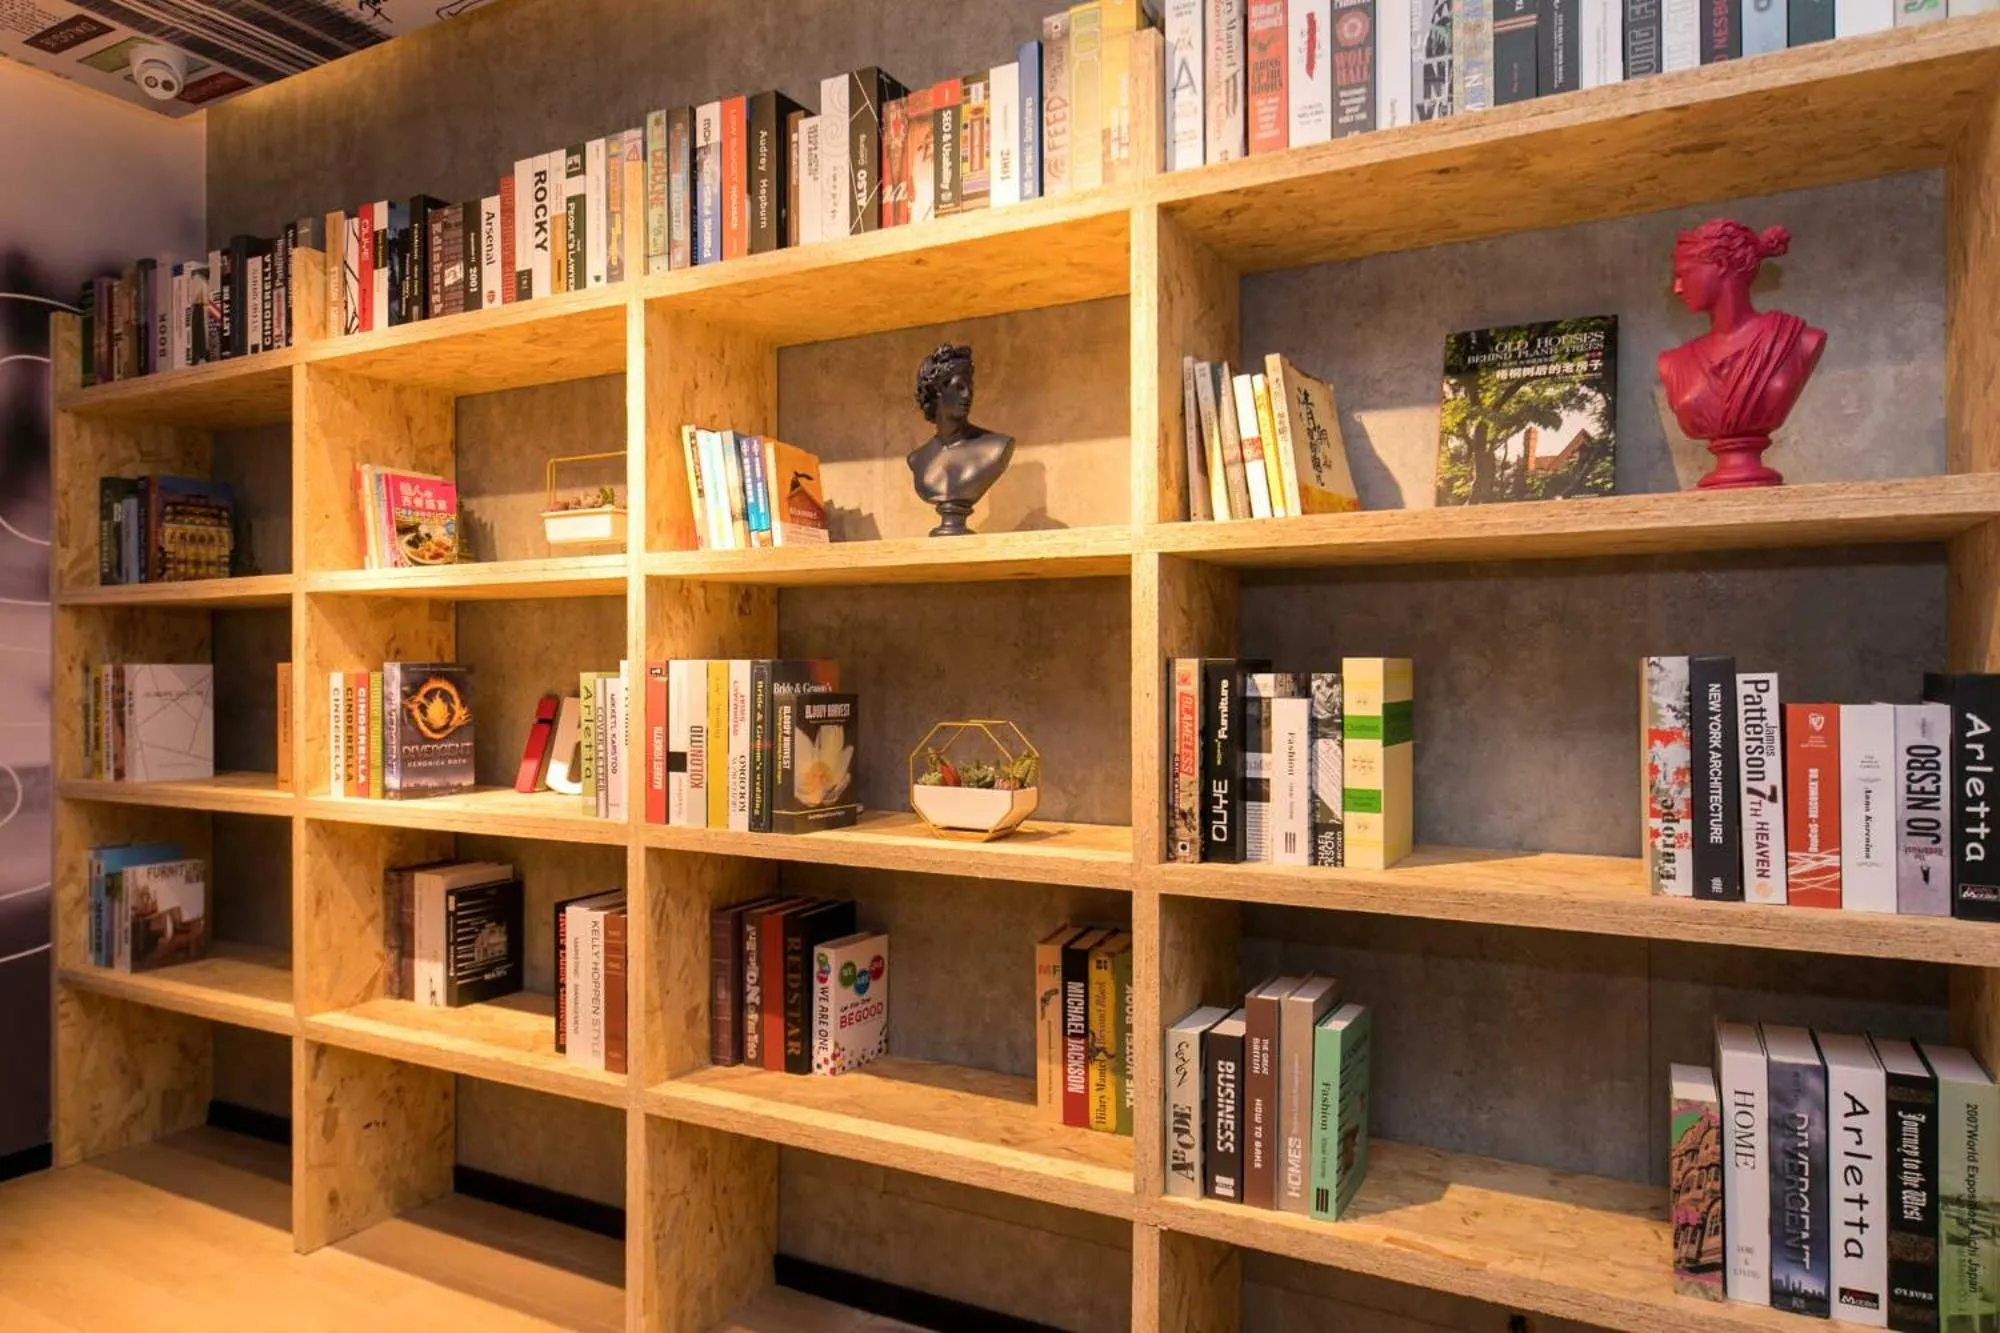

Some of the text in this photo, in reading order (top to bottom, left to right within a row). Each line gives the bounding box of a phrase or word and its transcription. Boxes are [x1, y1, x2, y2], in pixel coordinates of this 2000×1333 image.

[942, 109, 952, 130] SEO
[1047, 95, 1069, 152] FEED
[758, 130, 768, 229] Audrey Hepburn
[941, 143, 952, 190] Usability
[485, 211, 495, 266] Arsenal
[534, 170, 548, 252] ROCKY
[262, 253, 272, 346] CINDERELLA
[431, 222, 442, 314] Edinburgh
[469, 267, 478, 293] 2001
[159, 313, 167, 358] BOOK
[1467, 351, 1512, 365] BEHIND
[1495, 331, 1605, 353] OLD HOUSES
[773, 682, 795, 696] Bride
[794, 683, 801, 693] &
[1218, 679, 1229, 739] Furniture
[333, 687, 341, 781] CINDERELLA
[358, 687, 367, 784] CINDERELLA
[583, 685, 594, 779] Arletta
[1181, 696, 1194, 775] BLAMELESS
[1287, 732, 1295, 776] Fashion
[1708, 683, 1723, 845] NEW YORK ARCHITECTURE
[1742, 679, 1770, 783] Patterson
[1764, 722, 1776, 757] James
[1906, 744, 1942, 845] JO NESBO
[1965, 712, 1994, 862] Arletta
[1659, 799, 1680, 881] Europe
[1755, 821, 1771, 879] HEAVEN
[591, 920, 600, 1058] KELLY HOPPEN STYLE
[818, 986, 829, 1003] WE
[818, 1004, 829, 1026] ARE
[839, 1003, 883, 1030] BEGOOD
[1066, 981, 1085, 1094] MICHAEL JACKSON
[1172, 1104, 1195, 1182] ABCDE
[1216, 1060, 1236, 1154] BUSINESS
[1254, 1098, 1262, 1169] HOW TO BAKE
[1322, 1081, 1331, 1131] Fashion
[1734, 1088, 1756, 1171] HOME
[1287, 1136, 1302, 1198] HOMES
[1784, 1111, 1811, 1271] DIVERGENT
[1843, 1091, 1873, 1260] Arletta
[1897, 1110, 1928, 1221] Journey to the West
[1967, 1258, 1982, 1293] Japan
